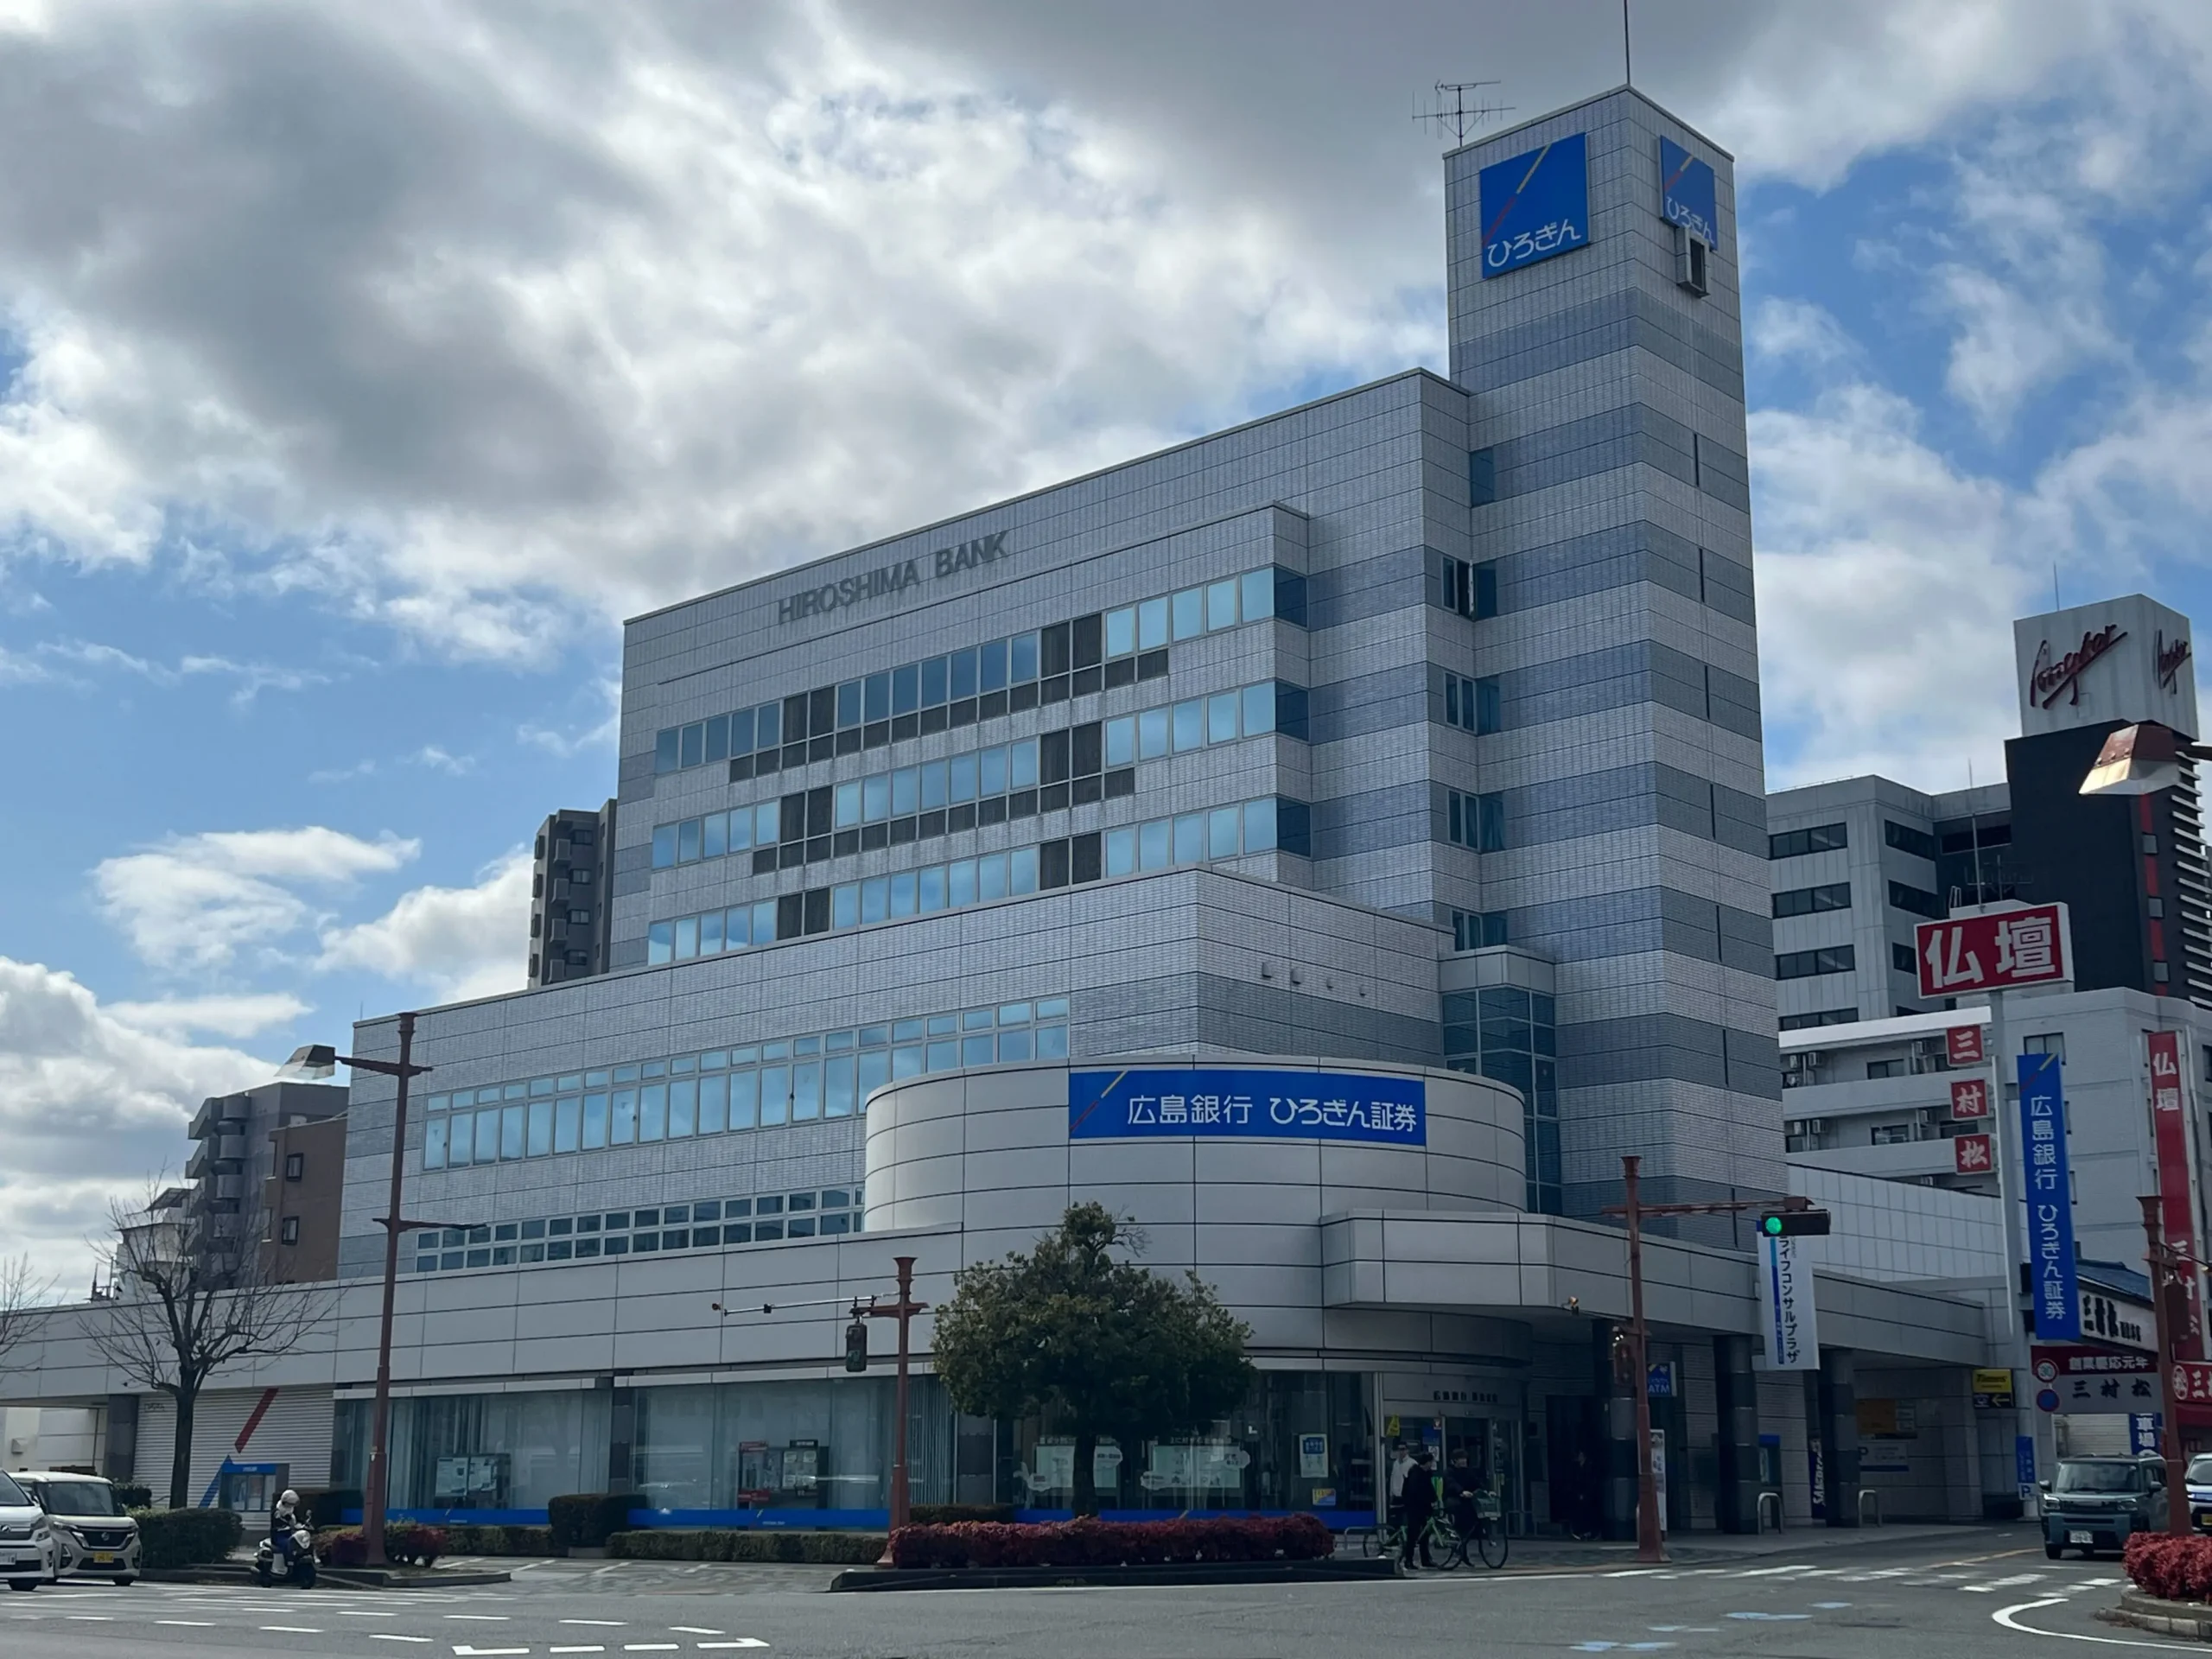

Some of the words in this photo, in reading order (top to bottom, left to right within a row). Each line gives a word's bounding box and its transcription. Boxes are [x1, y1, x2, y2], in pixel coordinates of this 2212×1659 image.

[1488, 218, 1581, 268] ひろぎん
[1667, 195, 1716, 245] ひろぎん
[778, 559, 921, 626] HIROSHIMA
[934, 530, 1010, 578] BANK
[1925, 916, 2056, 988] 仏壇
[2152, 1052, 2180, 1112] 仏壇
[1127, 1094, 1253, 1125] 広島銀行
[1269, 1097, 1418, 1132] ひろぎん証券
[2031, 1095, 2058, 1190] 広島銀行
[2037, 1205, 2067, 1320] ひろぎん証券
[1648, 1384, 1670, 1394] ATM
[2072, 1377, 2152, 1399] 三村松
